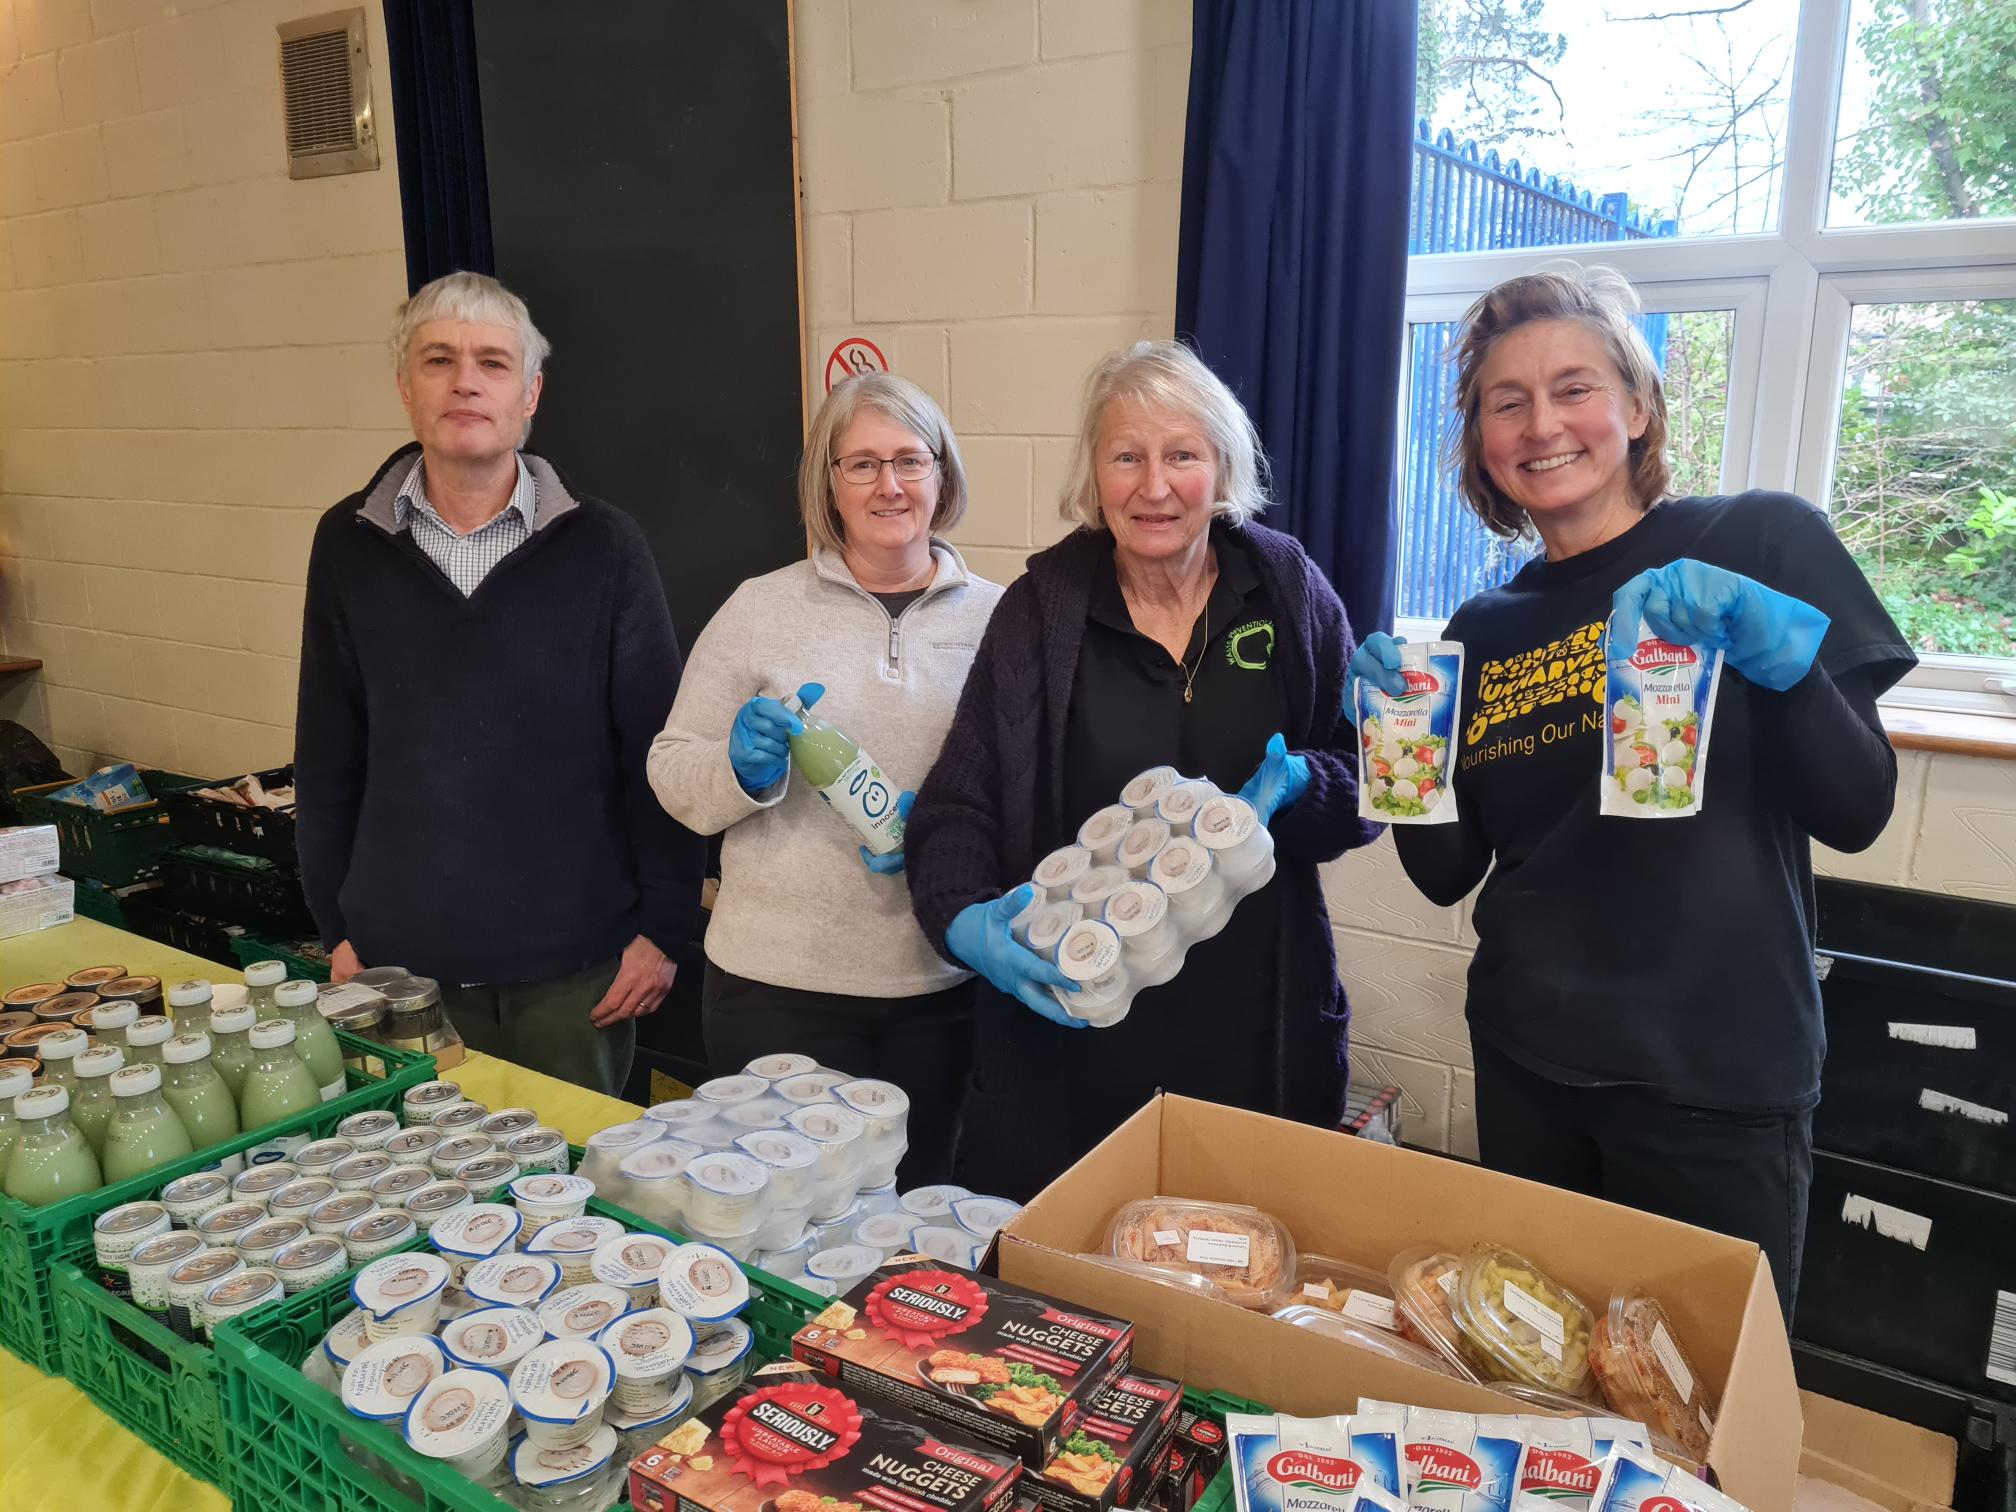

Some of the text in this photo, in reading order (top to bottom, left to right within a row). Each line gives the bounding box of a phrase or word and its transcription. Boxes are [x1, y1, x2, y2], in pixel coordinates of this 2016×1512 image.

[1632, 647, 1690, 665] Galbani
[1406, 677, 1432, 692] bani
[1483, 648, 1605, 702] UKHARVES
[1643, 683, 1691, 693] Mozzarella
[1656, 694, 1681, 705] Mini
[1385, 706, 1428, 717] Mozzarella
[1393, 718, 1417, 727] Mini
[1541, 722, 1575, 744] Our
[895, 1255, 917, 1263] NEW
[807, 1330, 822, 1339] 6
[1050, 1325, 1104, 1347] CHEESE
[1057, 1314, 1112, 1336] Original
[997, 1330, 1086, 1362] made with Scottish cheddar
[1002, 1320, 1096, 1356] NUGGETS
[355, 1360, 370, 1396] Natural
[522, 1359, 540, 1394] Natural
[1119, 1379, 1161, 1397] iginal
[1097, 1398, 1148, 1419] GETS
[1107, 1390, 1155, 1409] HEESE
[474, 1398, 502, 1435] Natural
[1109, 1414, 1139, 1425] cheddar
[752, 1426, 800, 1454] UNBEATABLE
[753, 1433, 789, 1454] FLAVOUR
[646, 1454, 664, 1466] 6
[935, 1446, 994, 1473] Original
[1419, 1454, 1471, 1482] lbani
[869, 1453, 970, 1500] NUGGETS
[923, 1460, 982, 1487] CHEESE
[1276, 1457, 1356, 1487] Galbani
[1522, 1458, 1594, 1489] albani
[861, 1467, 881, 1478] made
[881, 1474, 898, 1485] with
[898, 1480, 926, 1496] Scottish
[926, 1491, 957, 1507] cheddar
